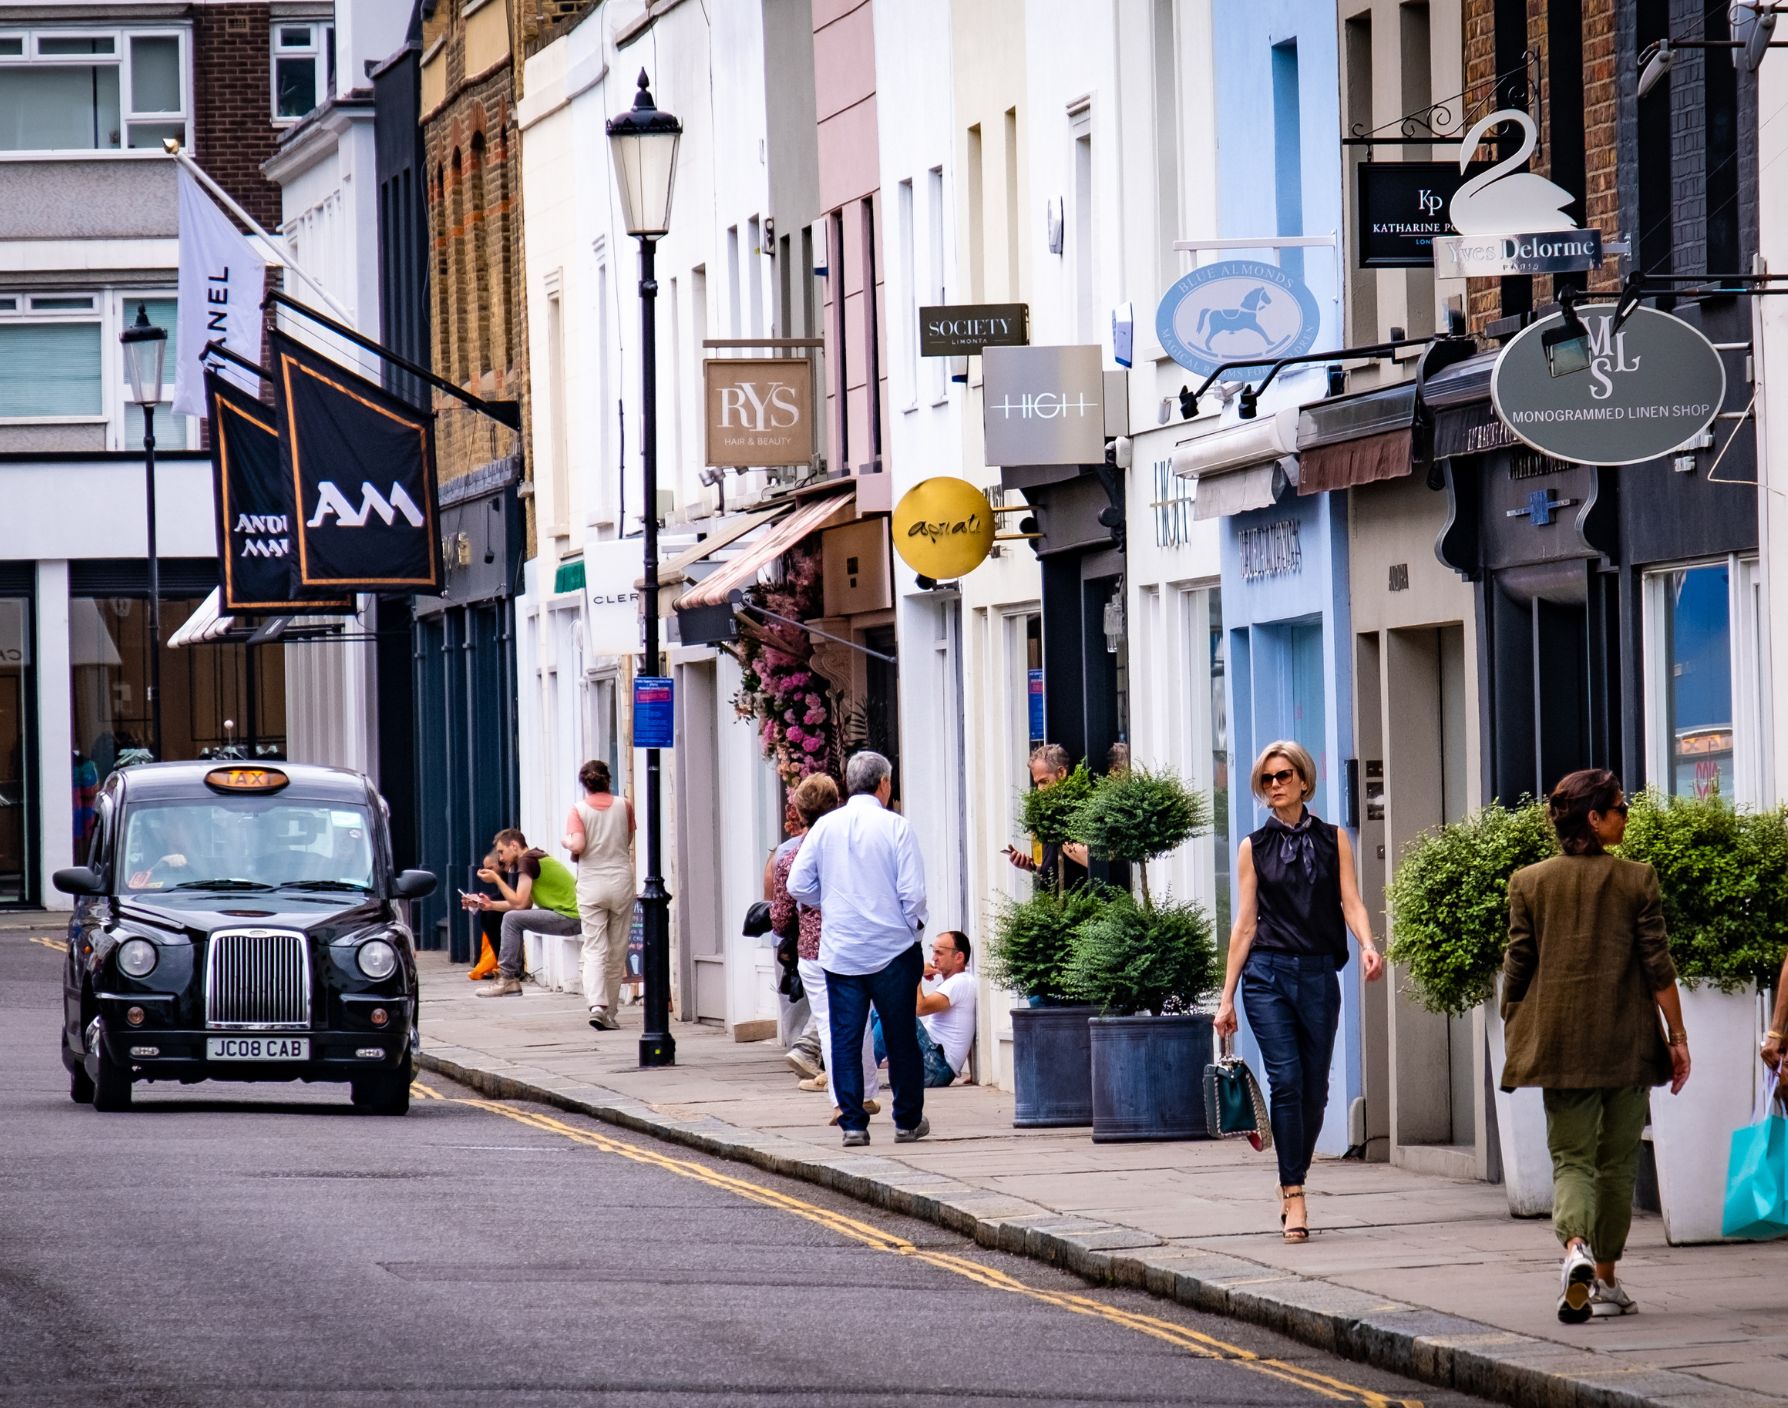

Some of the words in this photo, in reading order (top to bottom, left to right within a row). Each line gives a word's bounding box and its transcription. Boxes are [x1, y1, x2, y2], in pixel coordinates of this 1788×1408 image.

[1373, 223, 1441, 233] KATHARINE
[1446, 240, 1496, 263] Yves
[1500, 236, 1595, 260] Delorme
[1178, 267, 1217, 294] BLUE
[1221, 264, 1295, 289] ALMONDS
[928, 319, 1012, 337] SOCIETY
[715, 382, 800, 432] RYS
[1001, 392, 1087, 419] HIGH
[1512, 407, 1625, 423] MONOGRAMMED
[1628, 406, 1669, 419] LINEN
[1672, 404, 1710, 417] SHOP
[724, 438, 745, 446] HAIR
[747, 438, 755, 446] &
[757, 437, 792, 446] BEAUTY
[306, 481, 424, 527] AM
[224, 772, 271, 785] TAXI
[214, 1040, 262, 1057] JC08
[266, 1040, 302, 1057] CAB
